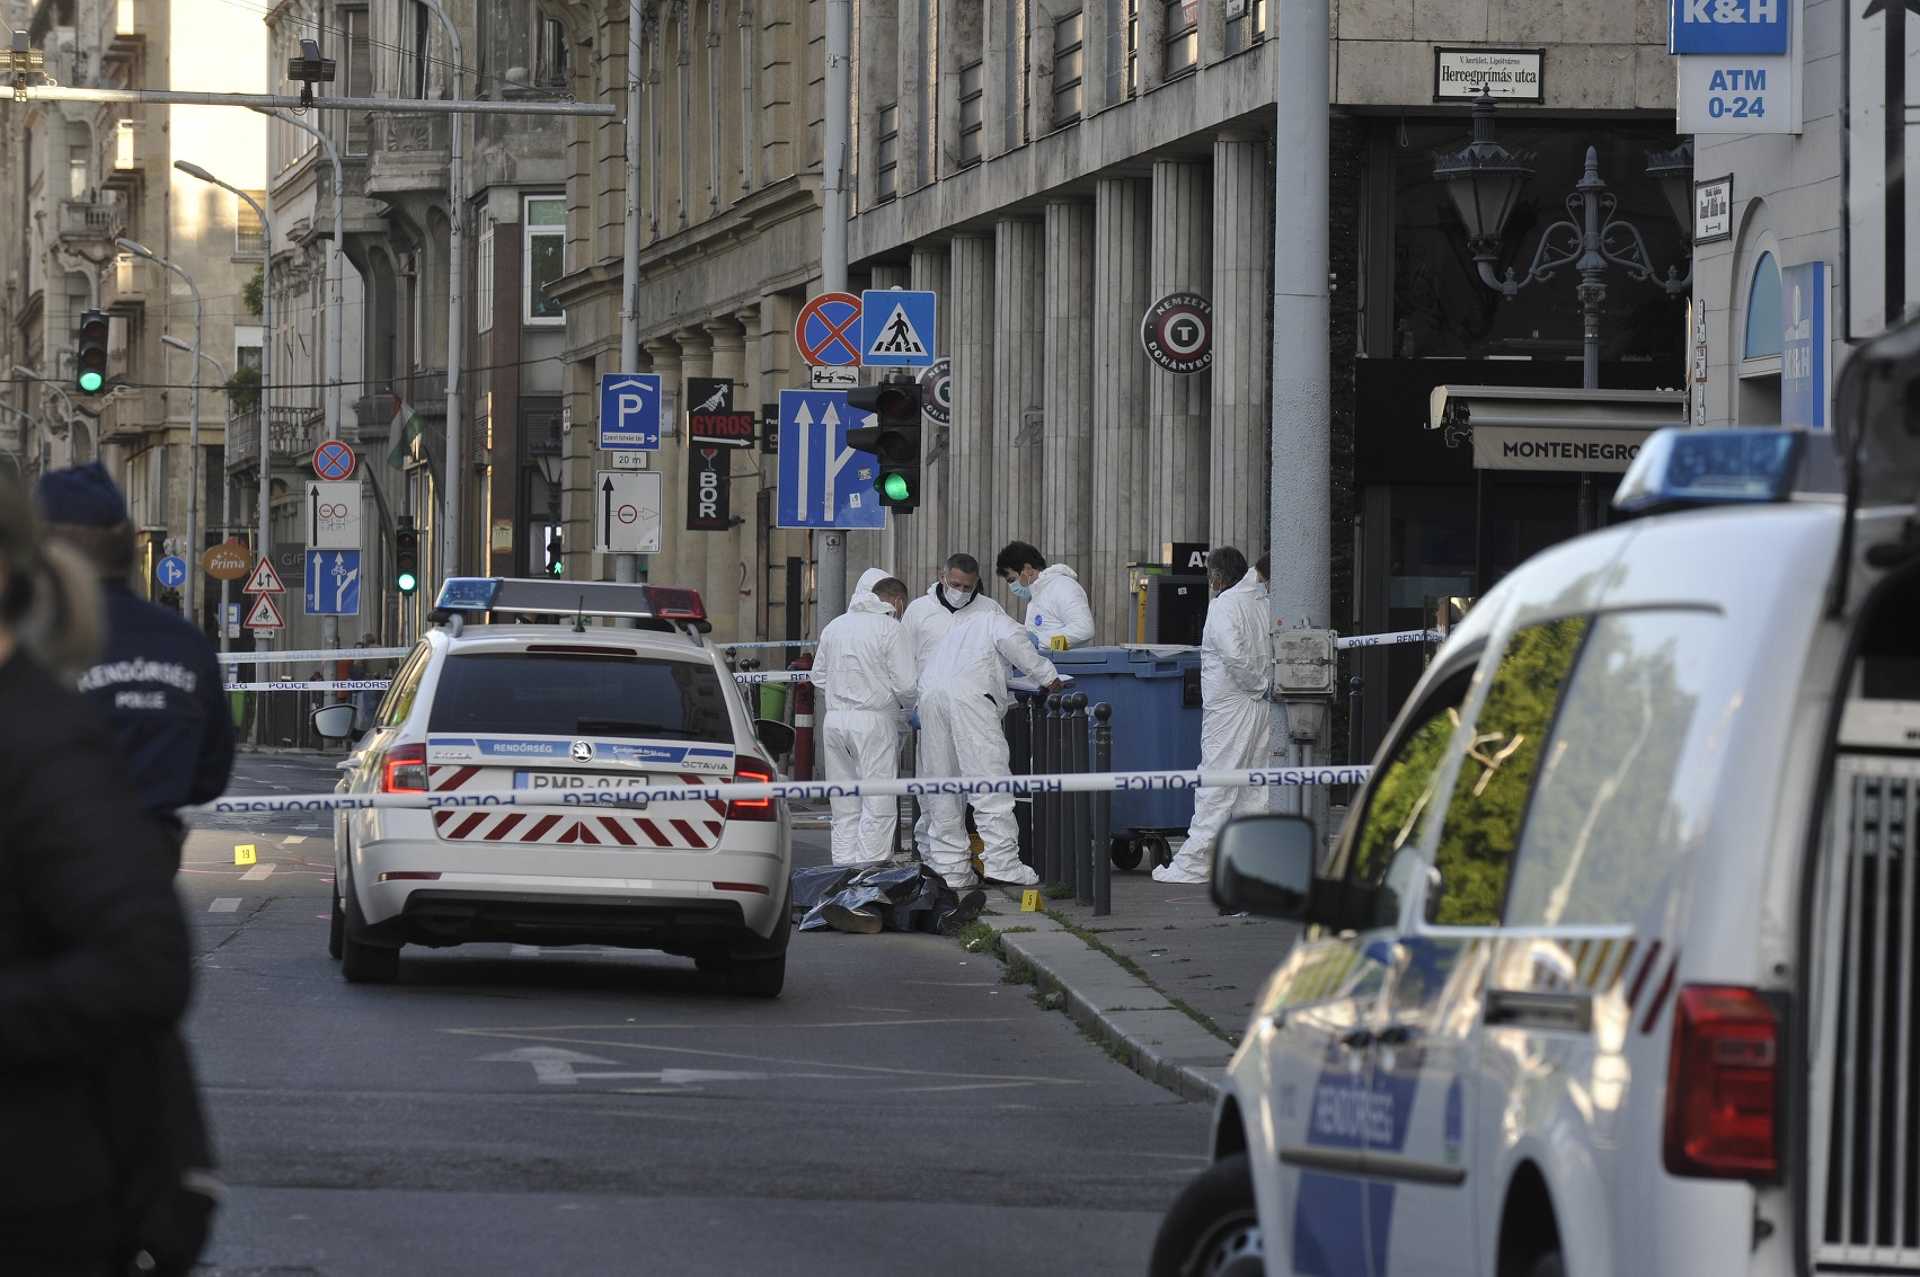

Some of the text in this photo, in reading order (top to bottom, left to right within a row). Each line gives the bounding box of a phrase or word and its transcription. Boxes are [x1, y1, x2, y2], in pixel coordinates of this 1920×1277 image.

[1683, 0, 1778, 24] K&H
[1442, 65, 1537, 85] Hercegprímás utca
[1709, 69, 1767, 91] ATM
[1708, 97, 1765, 118] 0-24
[1156, 296, 1212, 316] NEMZETI
[1177, 327, 1193, 341] T
[618, 394, 643, 428] P
[693, 415, 751, 434] GYROS
[1503, 441, 1641, 460] MONTENEGRO
[619, 456, 629, 464] 20
[699, 471, 718, 518] BOR
[210, 560, 245, 569] Prima
[268, 682, 309, 690] POLICE
[681, 760, 729, 771] OCTAVIA
[1114, 774, 1202, 790] POLICE
[427, 794, 517, 807] POLICE
[772, 785, 861, 799] POLICE
[1027, 894, 1033, 906] 5
